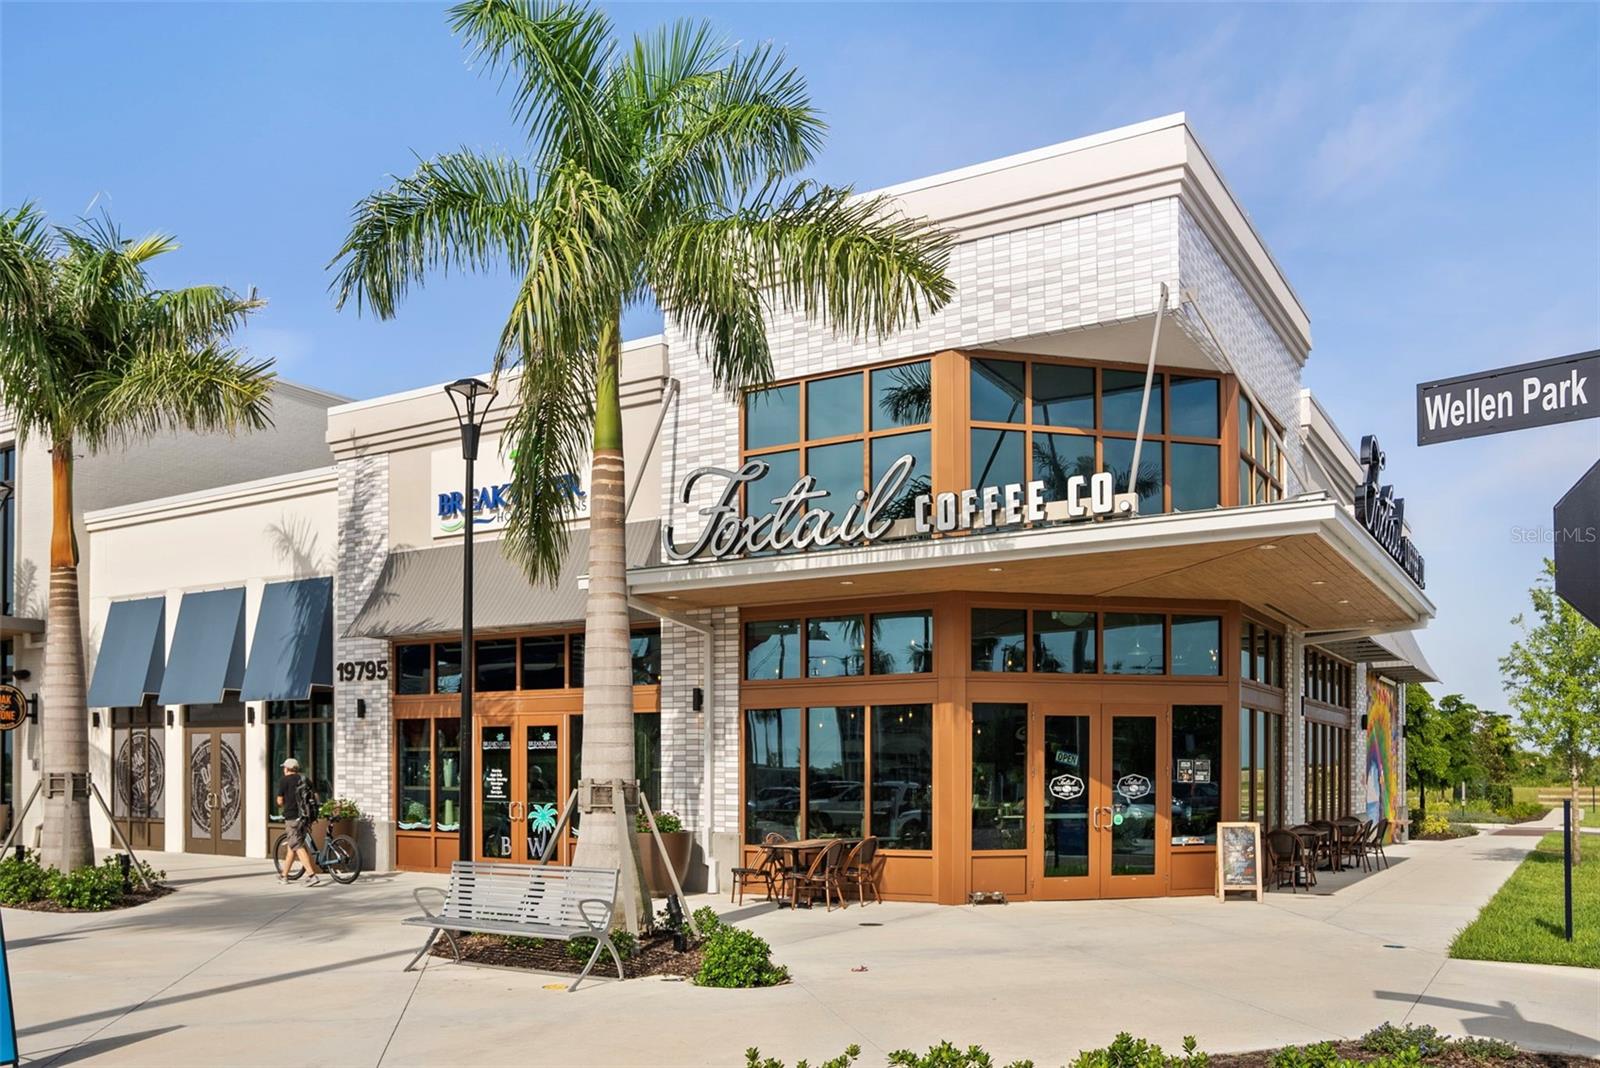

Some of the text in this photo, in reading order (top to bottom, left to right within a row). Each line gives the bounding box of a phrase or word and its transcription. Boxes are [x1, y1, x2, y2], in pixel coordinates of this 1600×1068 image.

[1424, 369, 1588, 431] Wellen Park
[663, 454, 1131, 561] Foxtail COFFEE CO.
[336, 660, 388, 682] 19795
[1057, 752, 1077, 765] OPEN
[501, 836, 512, 856] B
[527, 837, 547, 857] W
